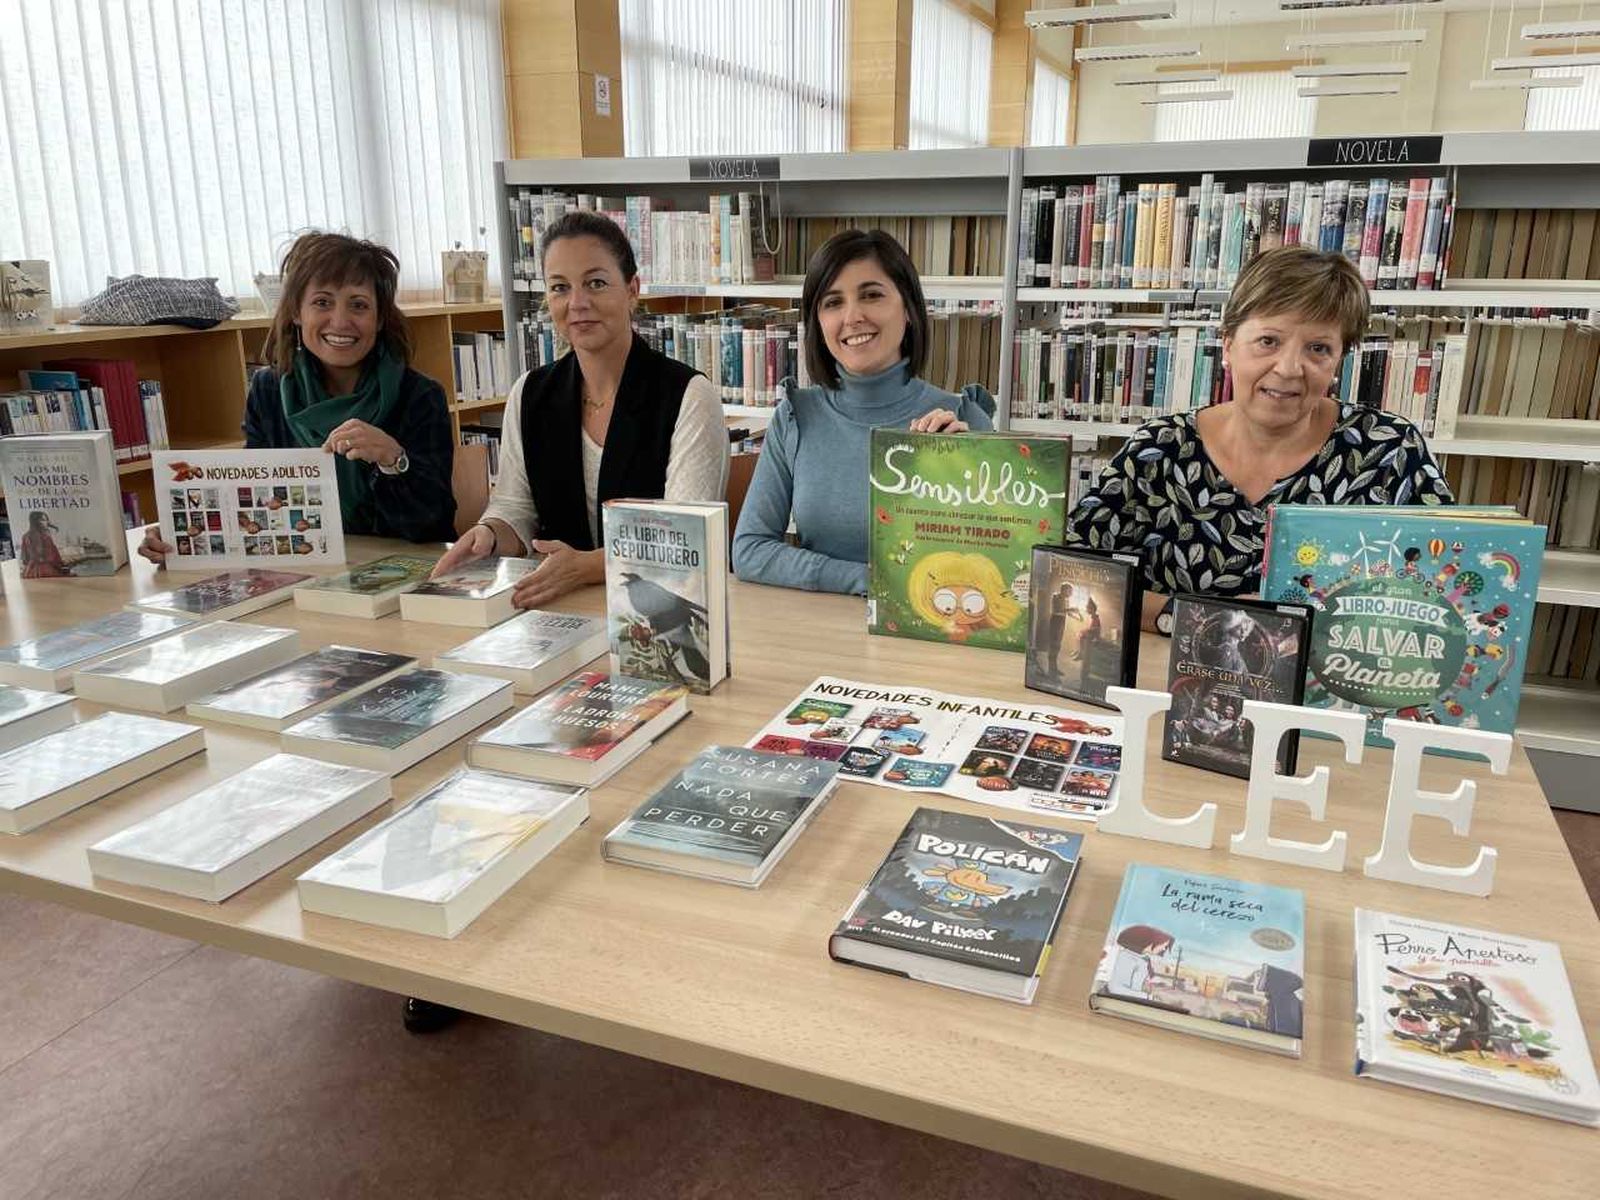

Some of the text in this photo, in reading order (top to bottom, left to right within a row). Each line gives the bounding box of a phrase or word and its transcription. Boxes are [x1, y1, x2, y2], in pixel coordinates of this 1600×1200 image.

[1335, 140, 1409, 163] NOVELA
[709, 159, 760, 179] NOVELA
[13, 474, 90, 487] NOMBRES
[28, 465, 69, 473] LOS MIL
[207, 465, 321, 480] NOVEDADES ADULTOS
[870, 444, 1065, 508] Sensibles
[54, 487, 68, 495] LA
[19, 497, 90, 509] LIBERTAD
[619, 524, 689, 547] EL LIBRO DEL
[915, 521, 1010, 540] MIRIAM TIRADO
[612, 538, 699, 567] SEPULTURERO
[1342, 599, 1440, 622] LIBRO-JUEGO
[1327, 624, 1446, 660] SALVAR
[1321, 653, 1441, 689] Planeta
[594, 682, 647, 696] MANEL
[563, 704, 639, 722] LADRONA
[814, 683, 1059, 726] NOVEDADES INFANTILES
[552, 714, 620, 731] HUESOS
[700, 761, 810, 785] FORTES
[701, 749, 820, 775] SUSANA
[675, 779, 752, 801] NADA
[1097, 686, 1512, 898] LEE
[644, 807, 769, 837] PERDER
[729, 805, 788, 823] QUE
[917, 833, 1051, 873] POLICÁN
[1160, 883, 1180, 897] La
[1186, 890, 1222, 905] rama
[1228, 900, 1263, 912] seca
[1171, 898, 1255, 921] del cerezo
[1373, 932, 1436, 956] Perro
